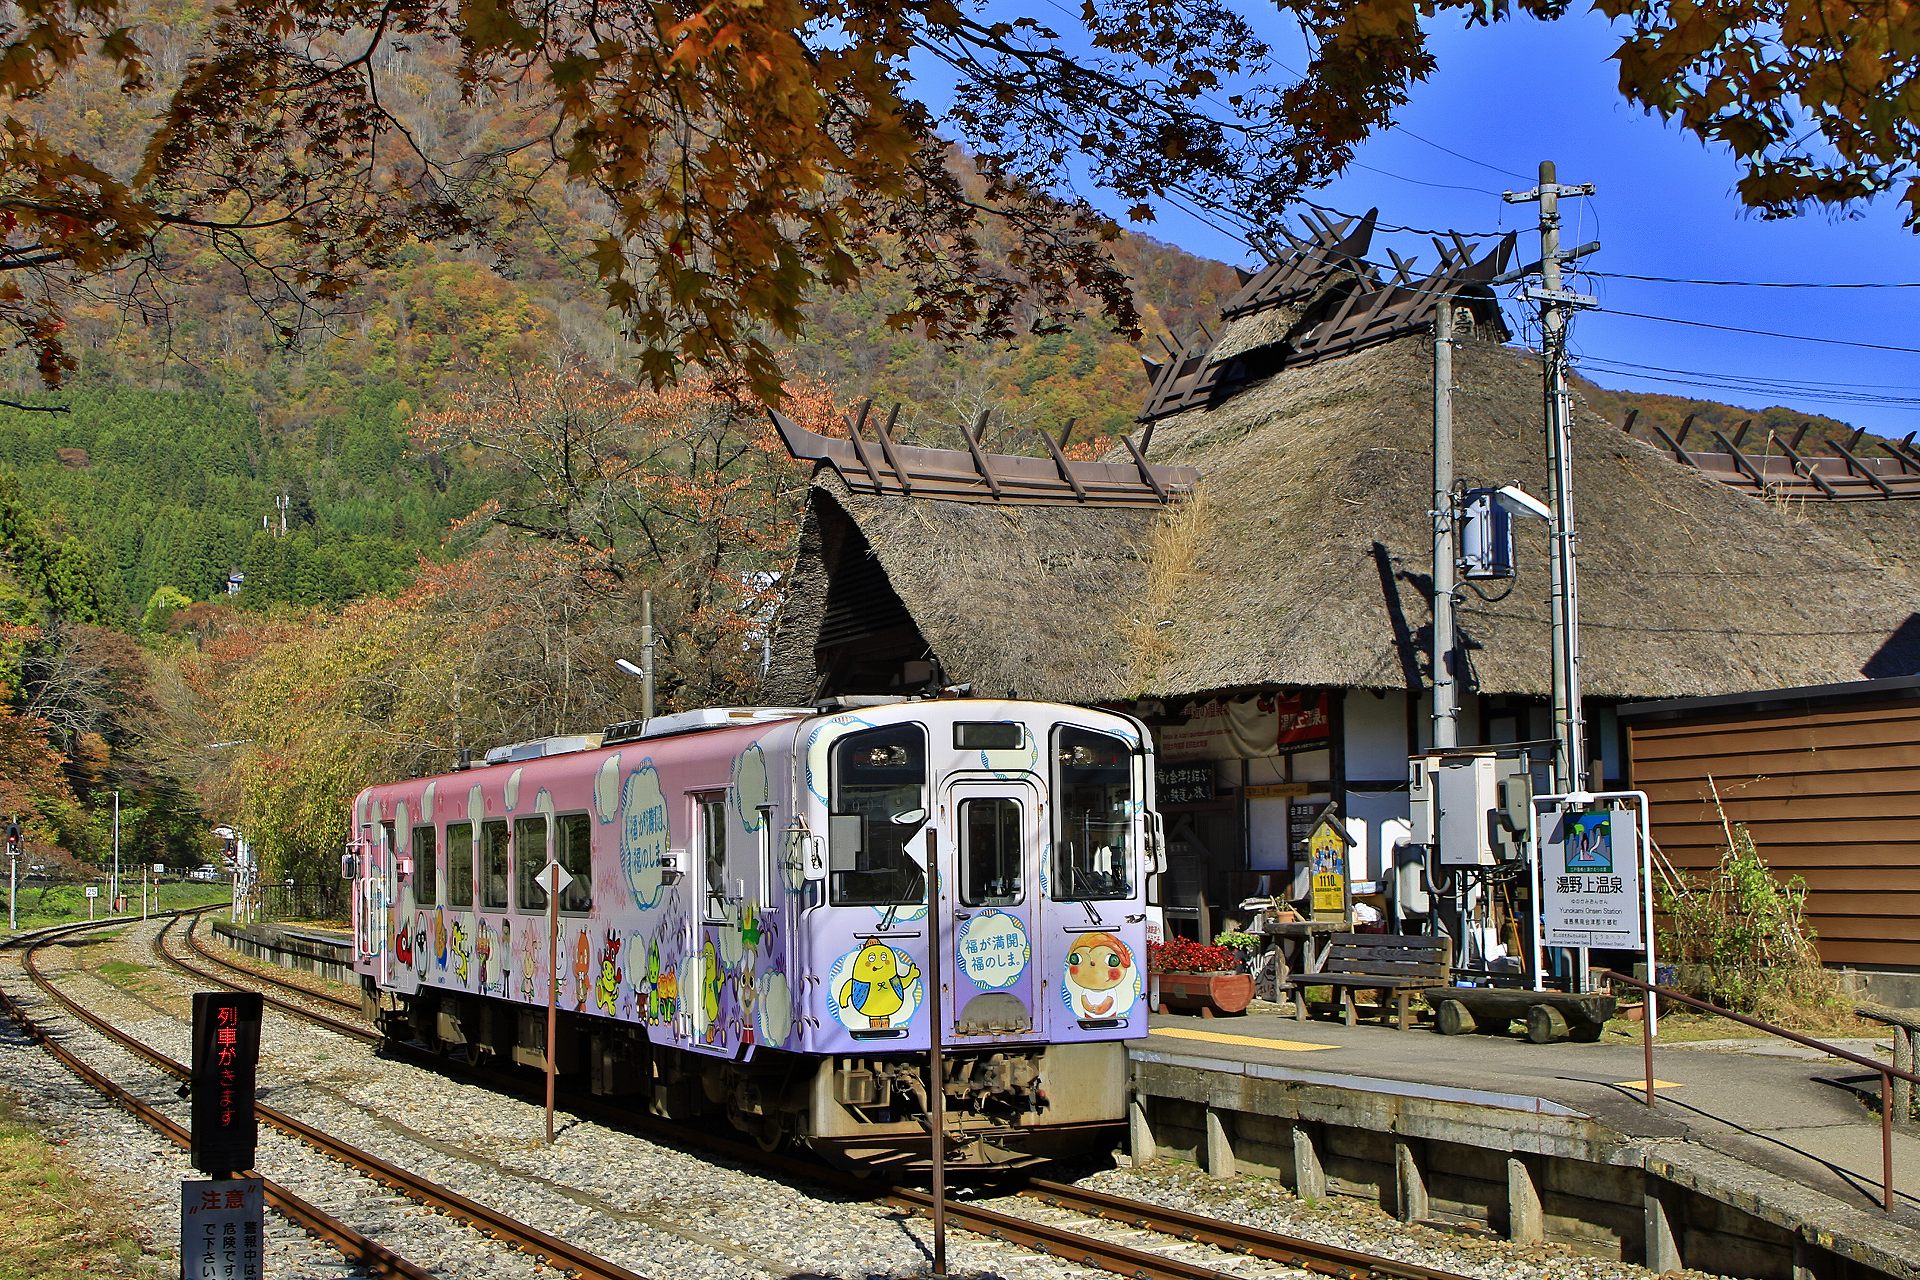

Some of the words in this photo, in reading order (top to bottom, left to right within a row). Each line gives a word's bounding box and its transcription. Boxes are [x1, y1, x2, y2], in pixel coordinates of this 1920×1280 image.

[1556, 876, 1623, 894] 湯野上温泉
[966, 933, 1024, 954] 福が満開、
[971, 952, 1020, 971] 福のしま。
[217, 1006, 237, 1127] 列車がきます
[202, 1223, 216, 1280] で下さい
[223, 1222, 236, 1280] 危険です
[244, 1221, 257, 1280] 警報中は
